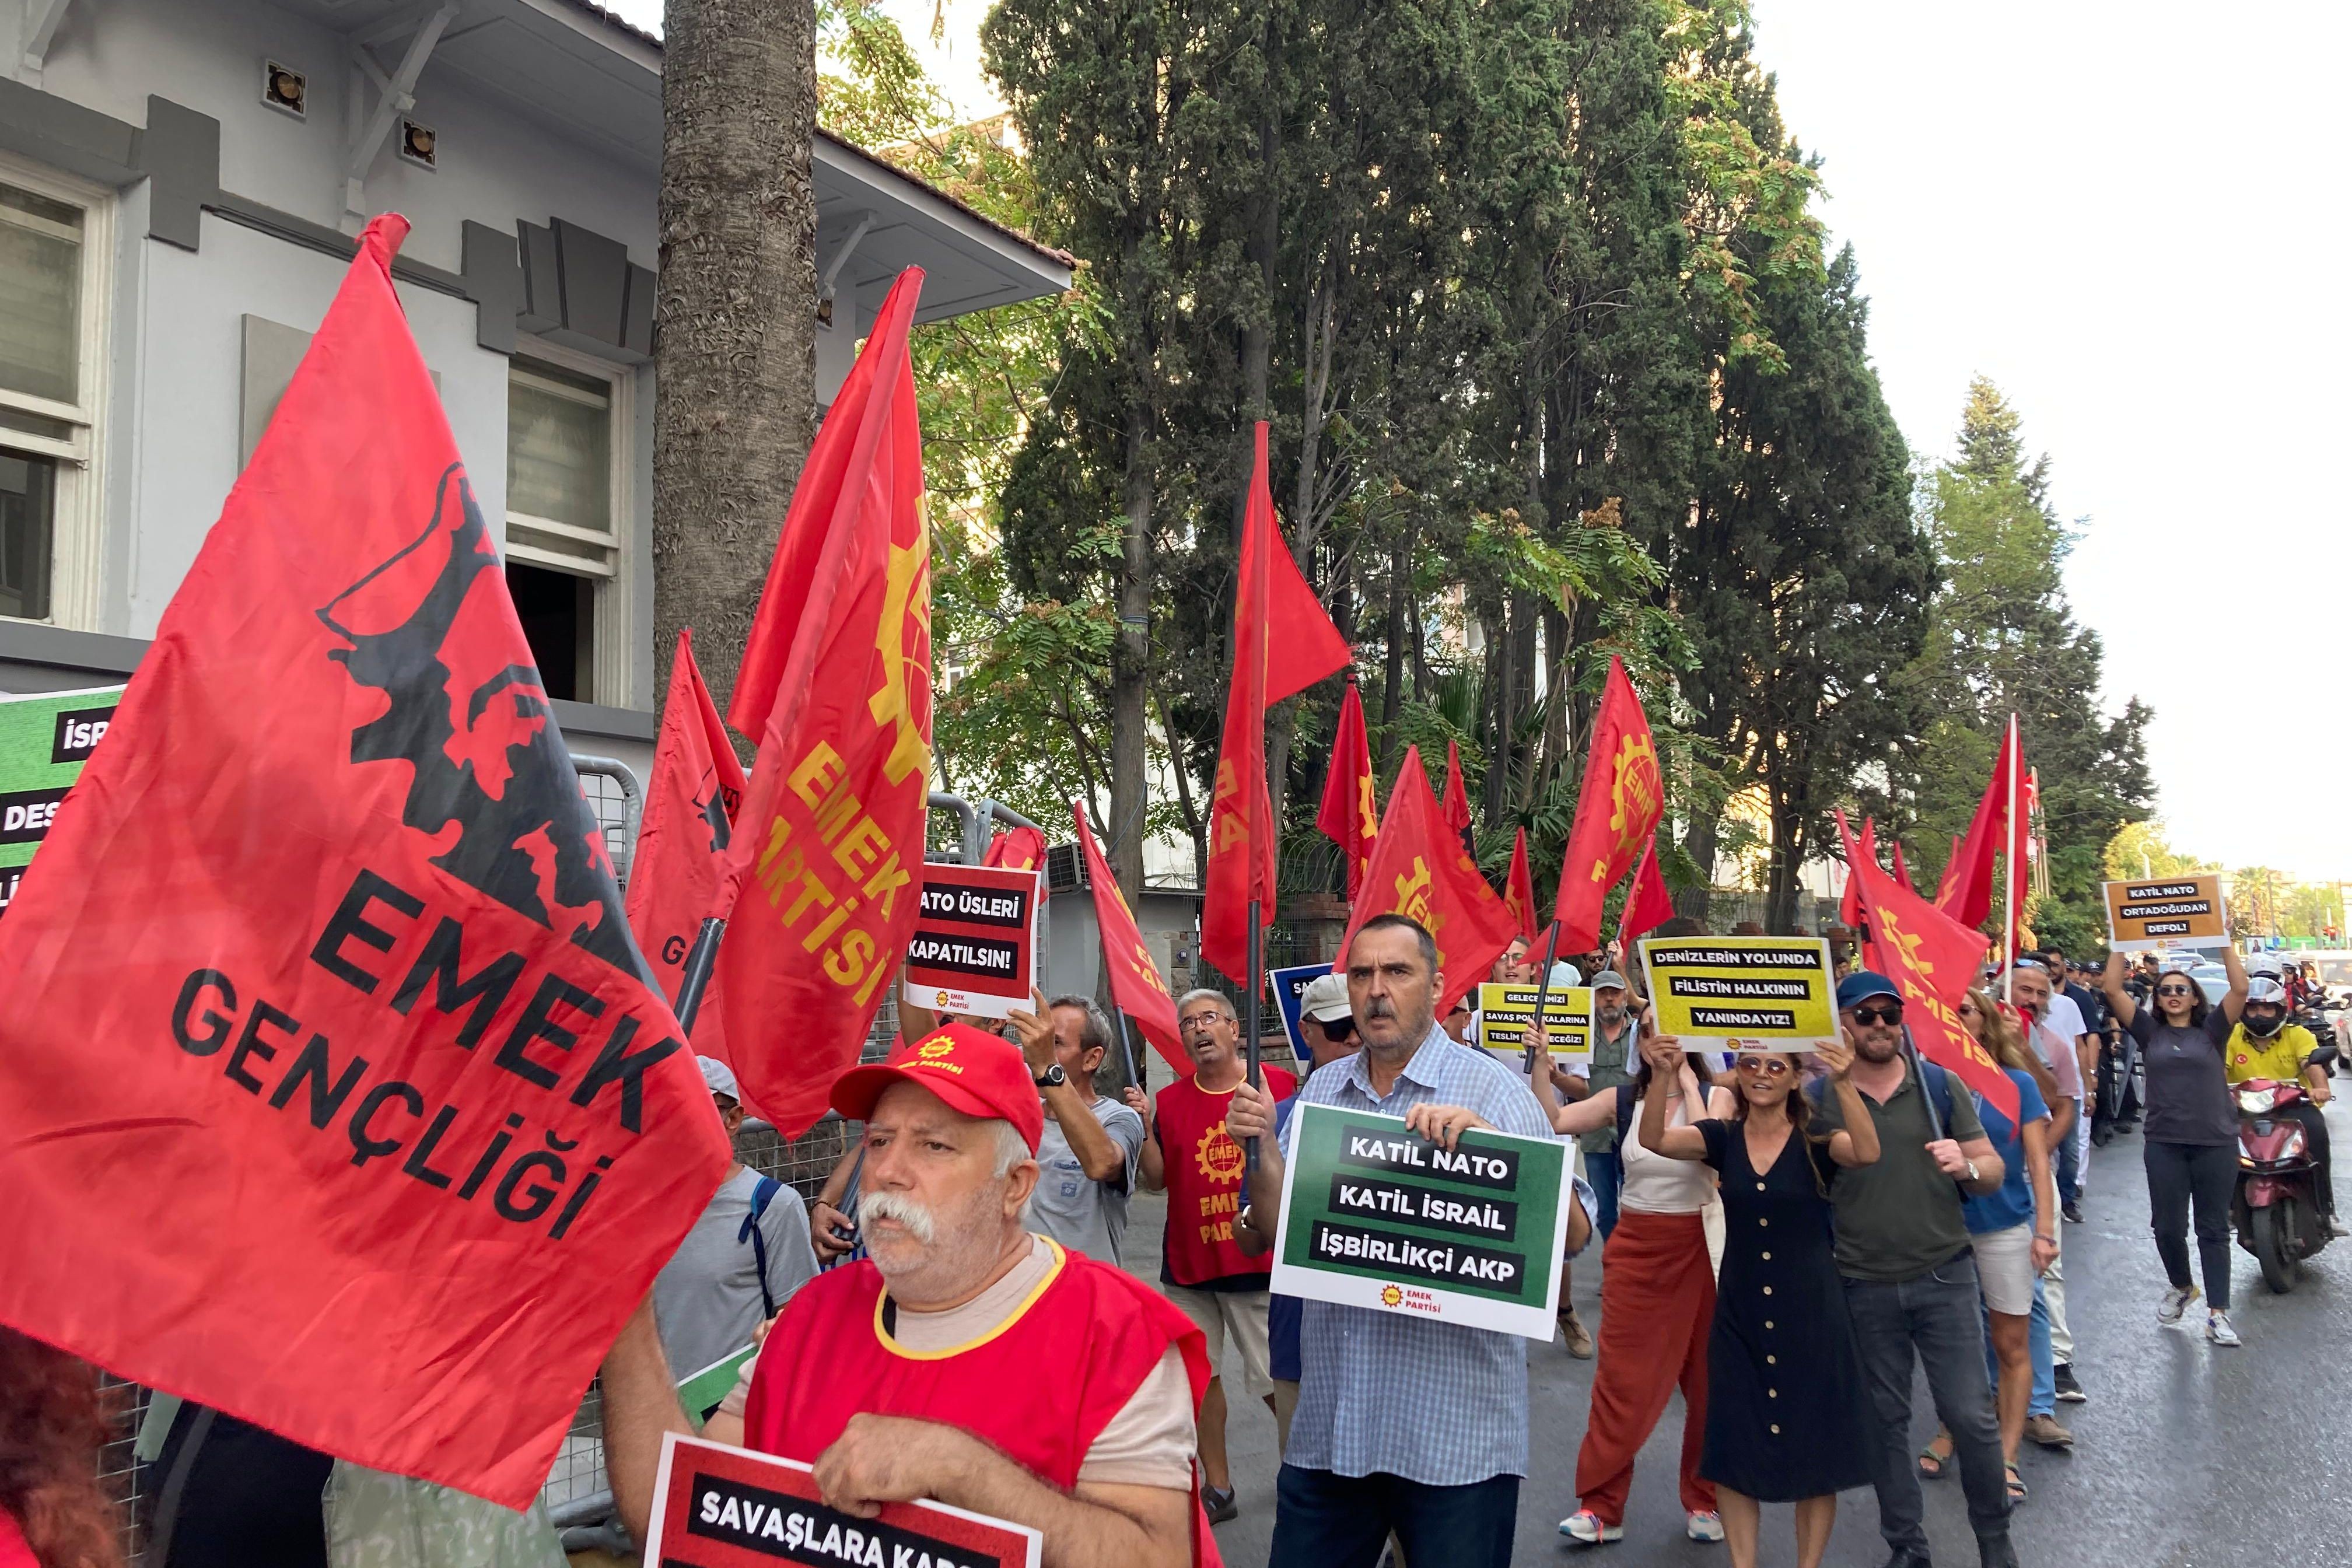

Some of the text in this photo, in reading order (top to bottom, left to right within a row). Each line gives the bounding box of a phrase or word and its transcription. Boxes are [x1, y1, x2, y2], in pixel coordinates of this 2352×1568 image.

[786, 740, 911, 923] EMEK
[2130, 886, 2195, 898] KATİL NATO
[921, 891, 1019, 918] ATO ÜSLERİ
[2123, 904, 2207, 916] ORTADOĞUDAN
[2148, 923, 2188, 933] DEFOL!
[908, 939, 1012, 970] KAPATILSIN!
[1655, 950, 1817, 965] DENİZLERİN YOLUNDA
[1675, 979, 1805, 996] FİLİSTİN HALKININ
[310, 867, 683, 1135] EMEK
[1507, 993, 1565, 1003] GELECEİMİZİ
[1486, 1013, 1515, 1021] SAVAŞ
[1695, 1011, 1791, 1026] YANINDAYIZ!
[1490, 1032, 1520, 1041] TESLİM
[170, 967, 615, 1241] GENÇLİĞİ
[1209, 1145, 1241, 1161] EMEP
[1350, 1136, 1508, 1180] KATİL NATO
[1199, 1192, 1240, 1216] EME
[1339, 1184, 1506, 1231] KATİL İSRAİL
[1320, 1227, 1515, 1282] İŞBİRLİKÇİ AKP
[1406, 1290, 1432, 1300] EMEK
[1406, 1300, 1441, 1314] PARTİSİ
[700, 1490, 885, 1568] SAVAŞLARA
